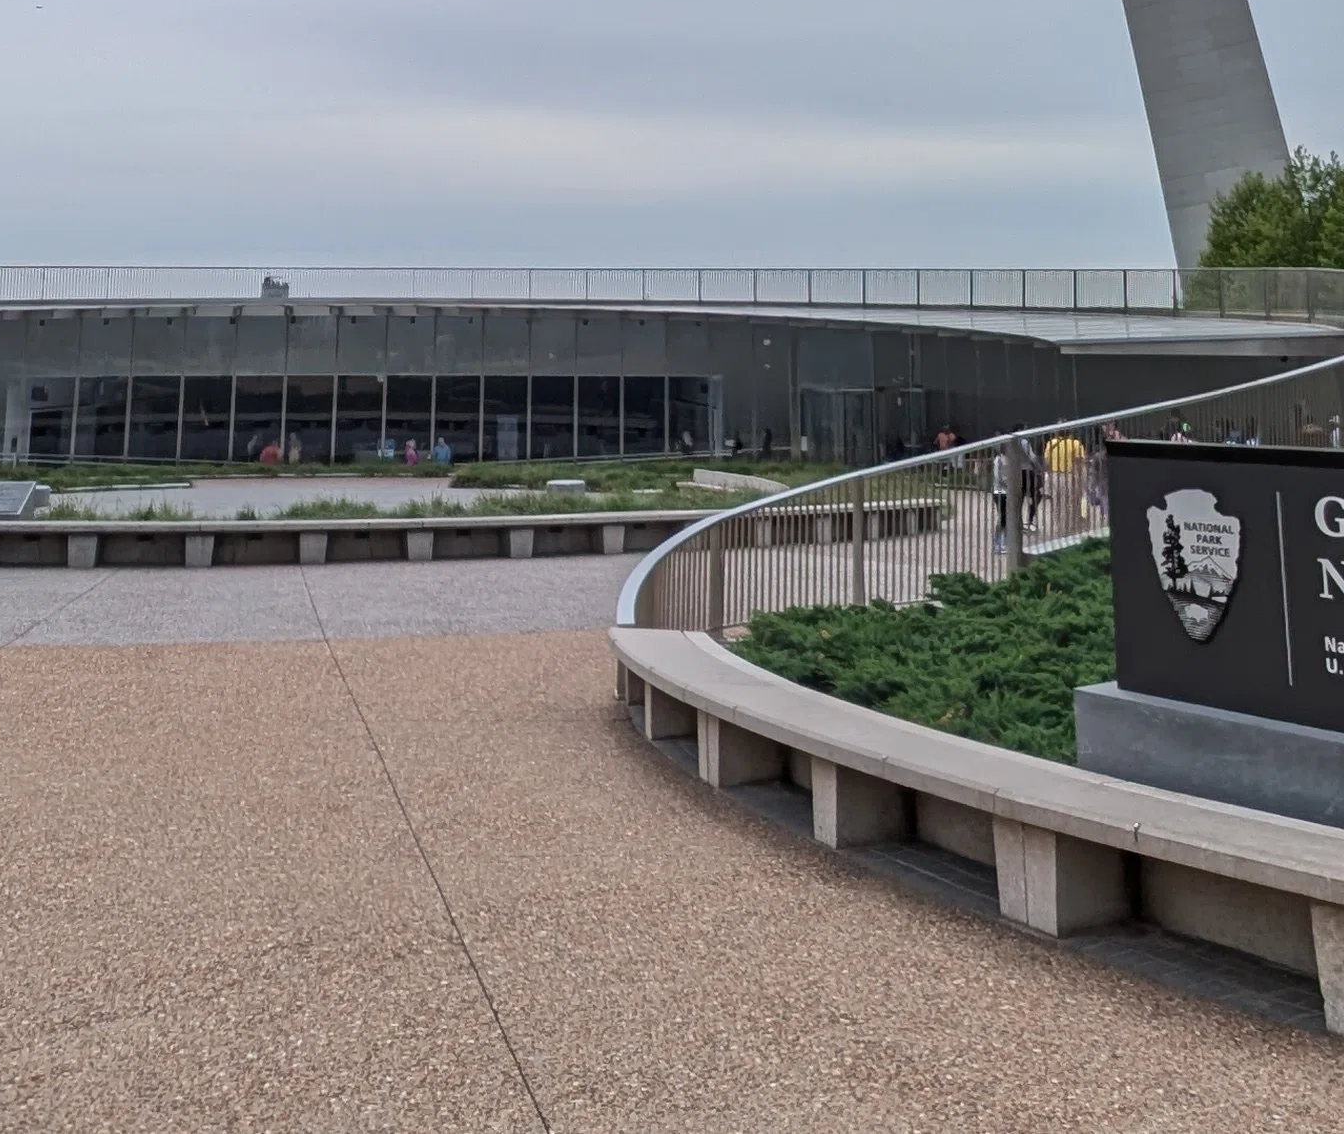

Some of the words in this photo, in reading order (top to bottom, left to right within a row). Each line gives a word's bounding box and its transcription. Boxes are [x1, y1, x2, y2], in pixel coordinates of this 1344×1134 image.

[1183, 521, 1234, 535] NATIONAL
[1196, 534, 1222, 545] PARK
[1190, 545, 1231, 558] SERVICE
